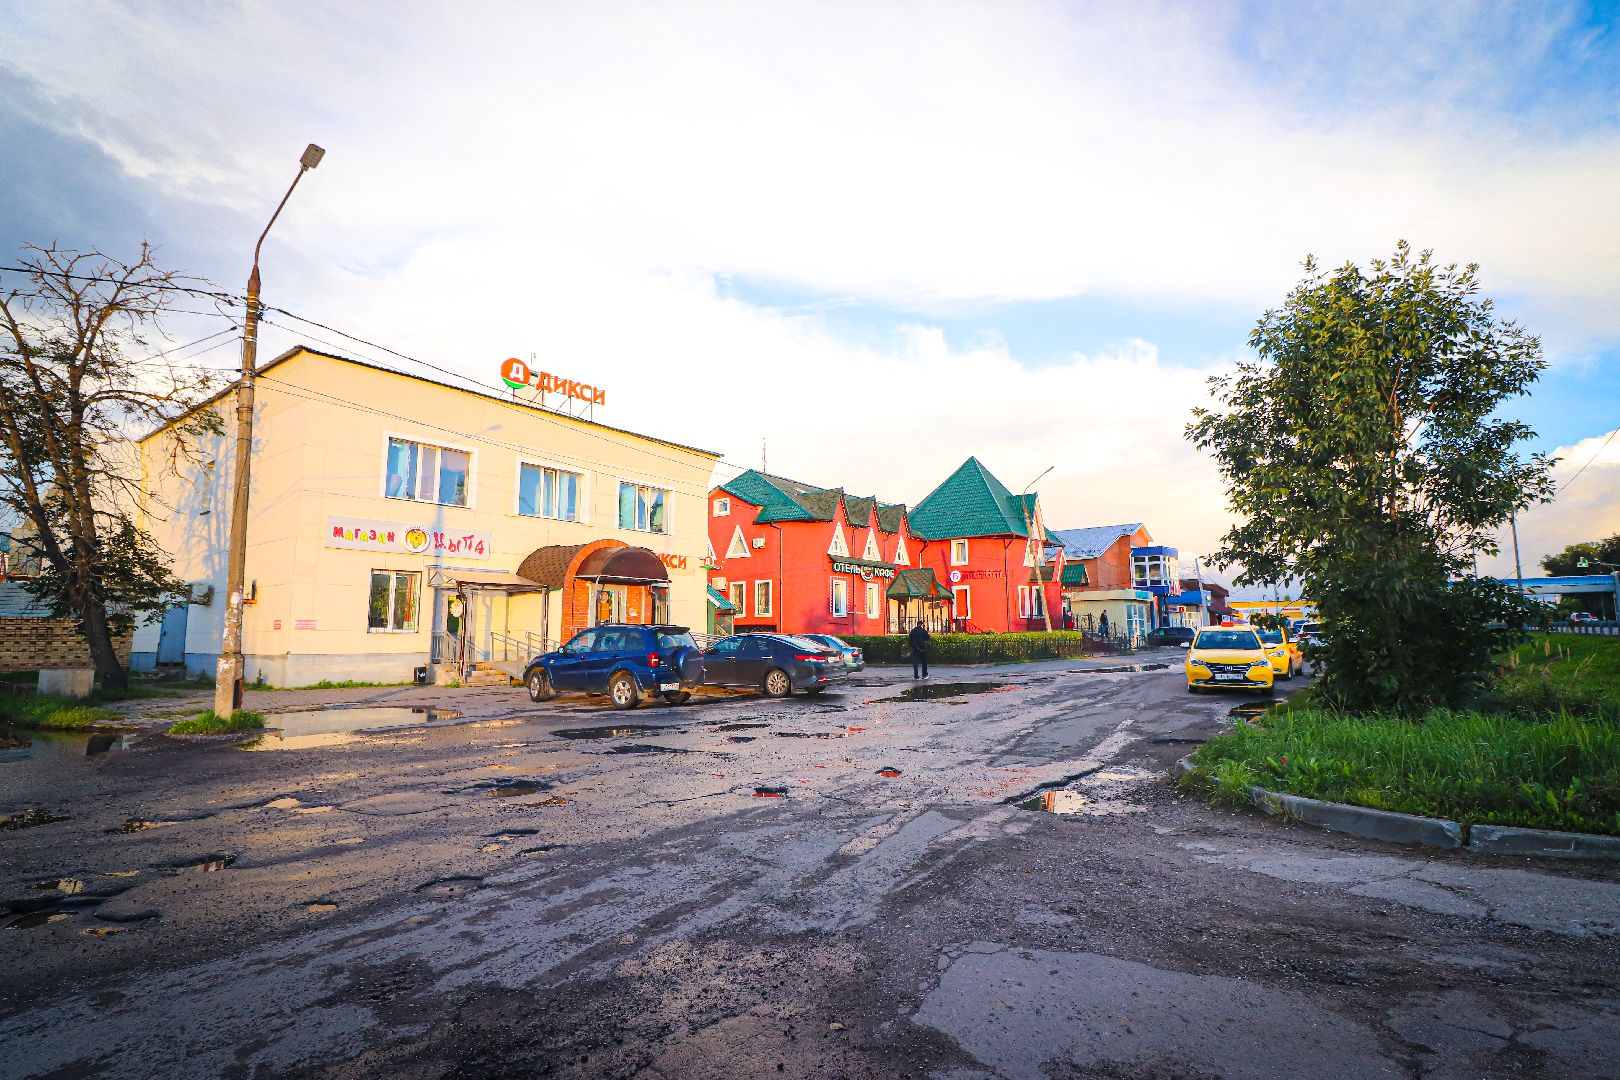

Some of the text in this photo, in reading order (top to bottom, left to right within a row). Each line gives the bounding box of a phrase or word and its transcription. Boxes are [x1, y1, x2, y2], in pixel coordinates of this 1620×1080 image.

[509, 362, 605, 406] Д ДИКСИ
[333, 526, 395, 544] МАГАЗИН
[657, 552, 687, 570] КСИ
[833, 562, 895, 579] ОТЕЛЬ КАФЕ
